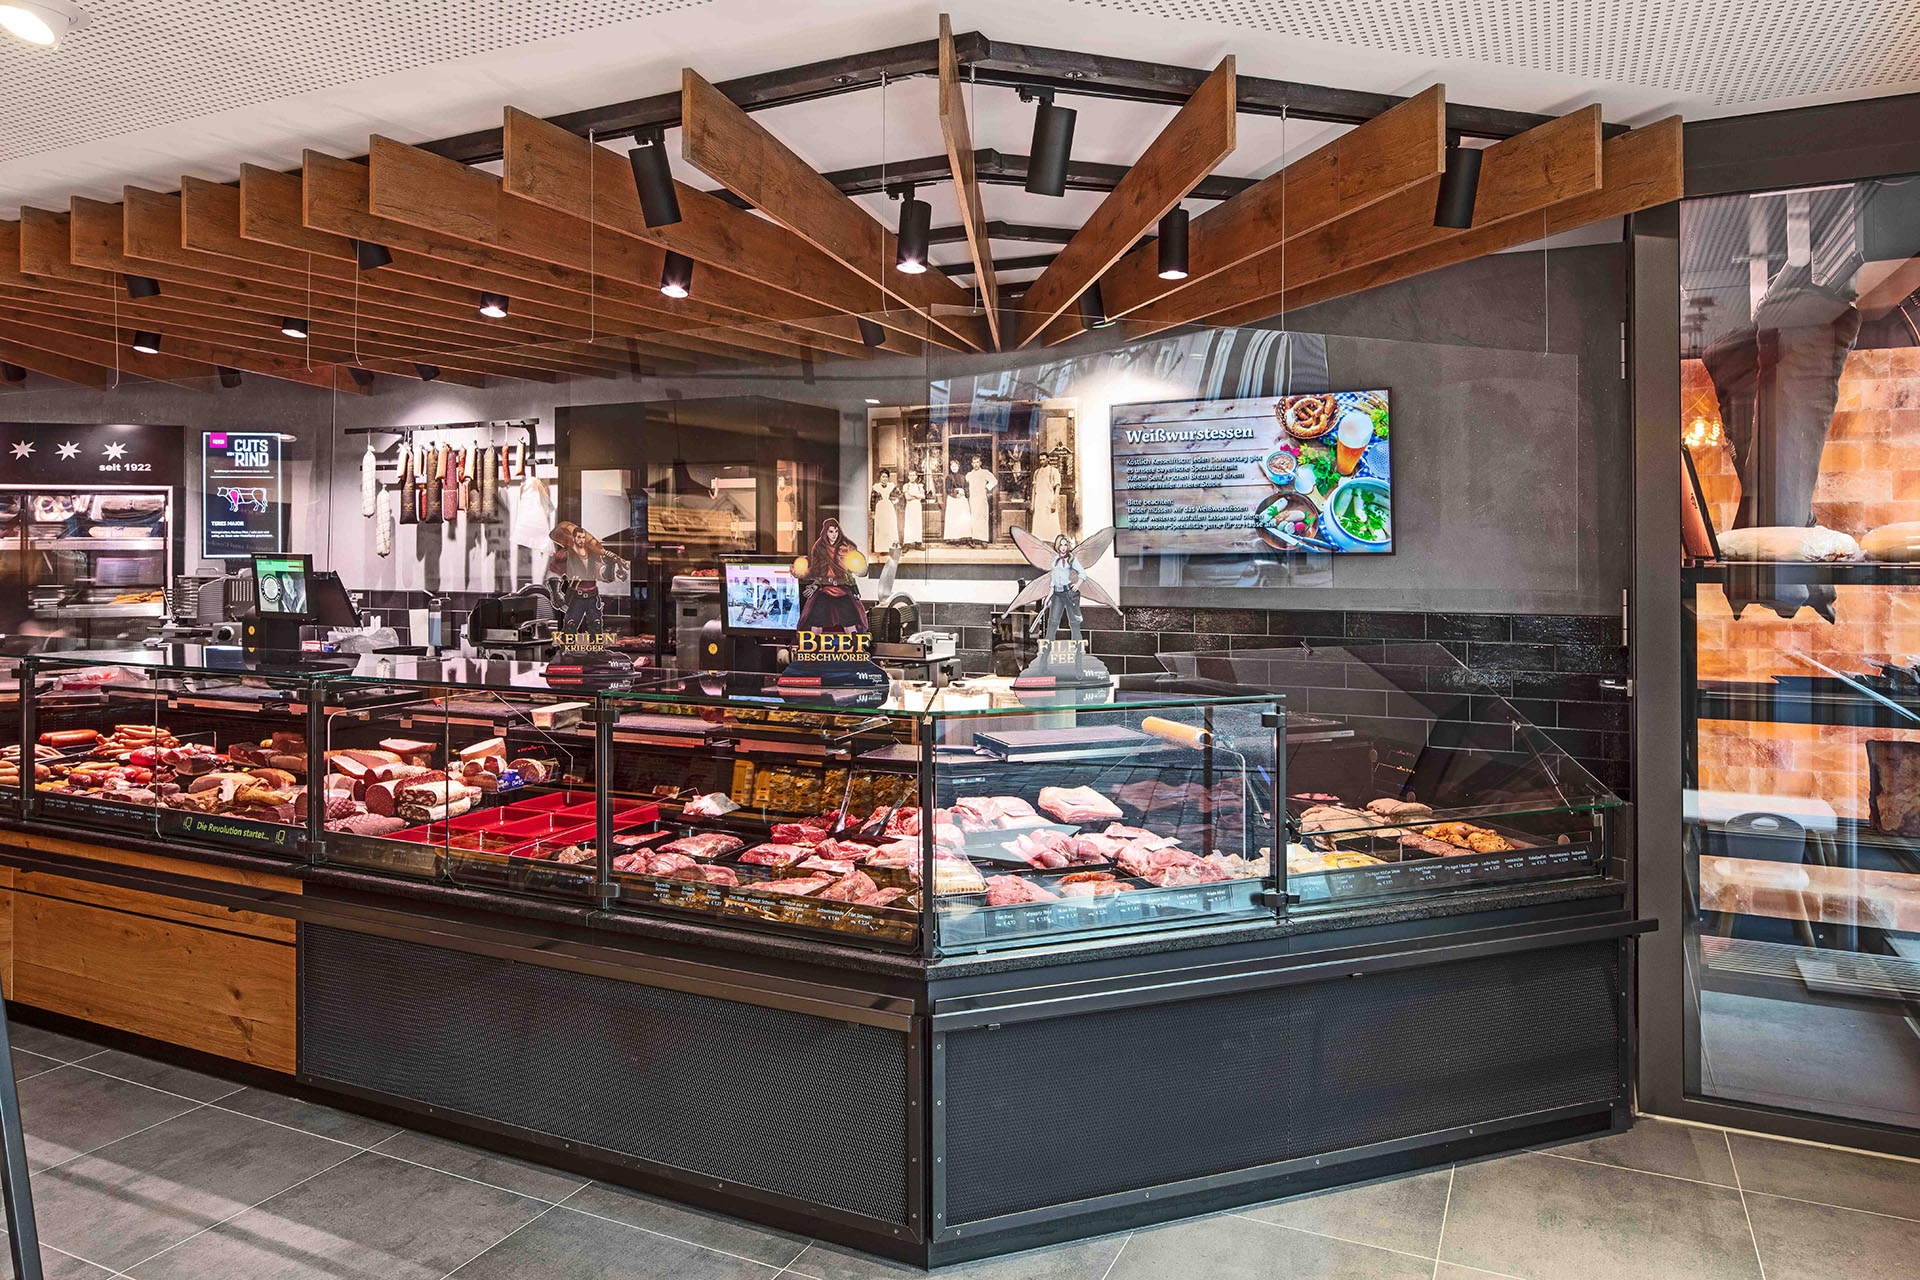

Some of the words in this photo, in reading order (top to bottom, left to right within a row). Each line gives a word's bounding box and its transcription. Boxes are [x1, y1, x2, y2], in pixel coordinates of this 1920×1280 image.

[1125, 427, 1254, 443] Weißwurstessen
[234, 439, 269, 452] CUTS
[234, 452, 269, 467] RIND
[99, 463, 121, 471] seit
[123, 463, 152, 472] 1922
[552, 631, 617, 646] KEULEN
[797, 630, 872, 653] BEEF
[564, 644, 606, 652] KRIEGER
[1036, 639, 1089, 655] FILET
[797, 651, 870, 662] BESCHWÖRER
[1049, 653, 1075, 665] FEE
[196, 821, 208, 831] Die
[208, 823, 242, 836] Revolution
